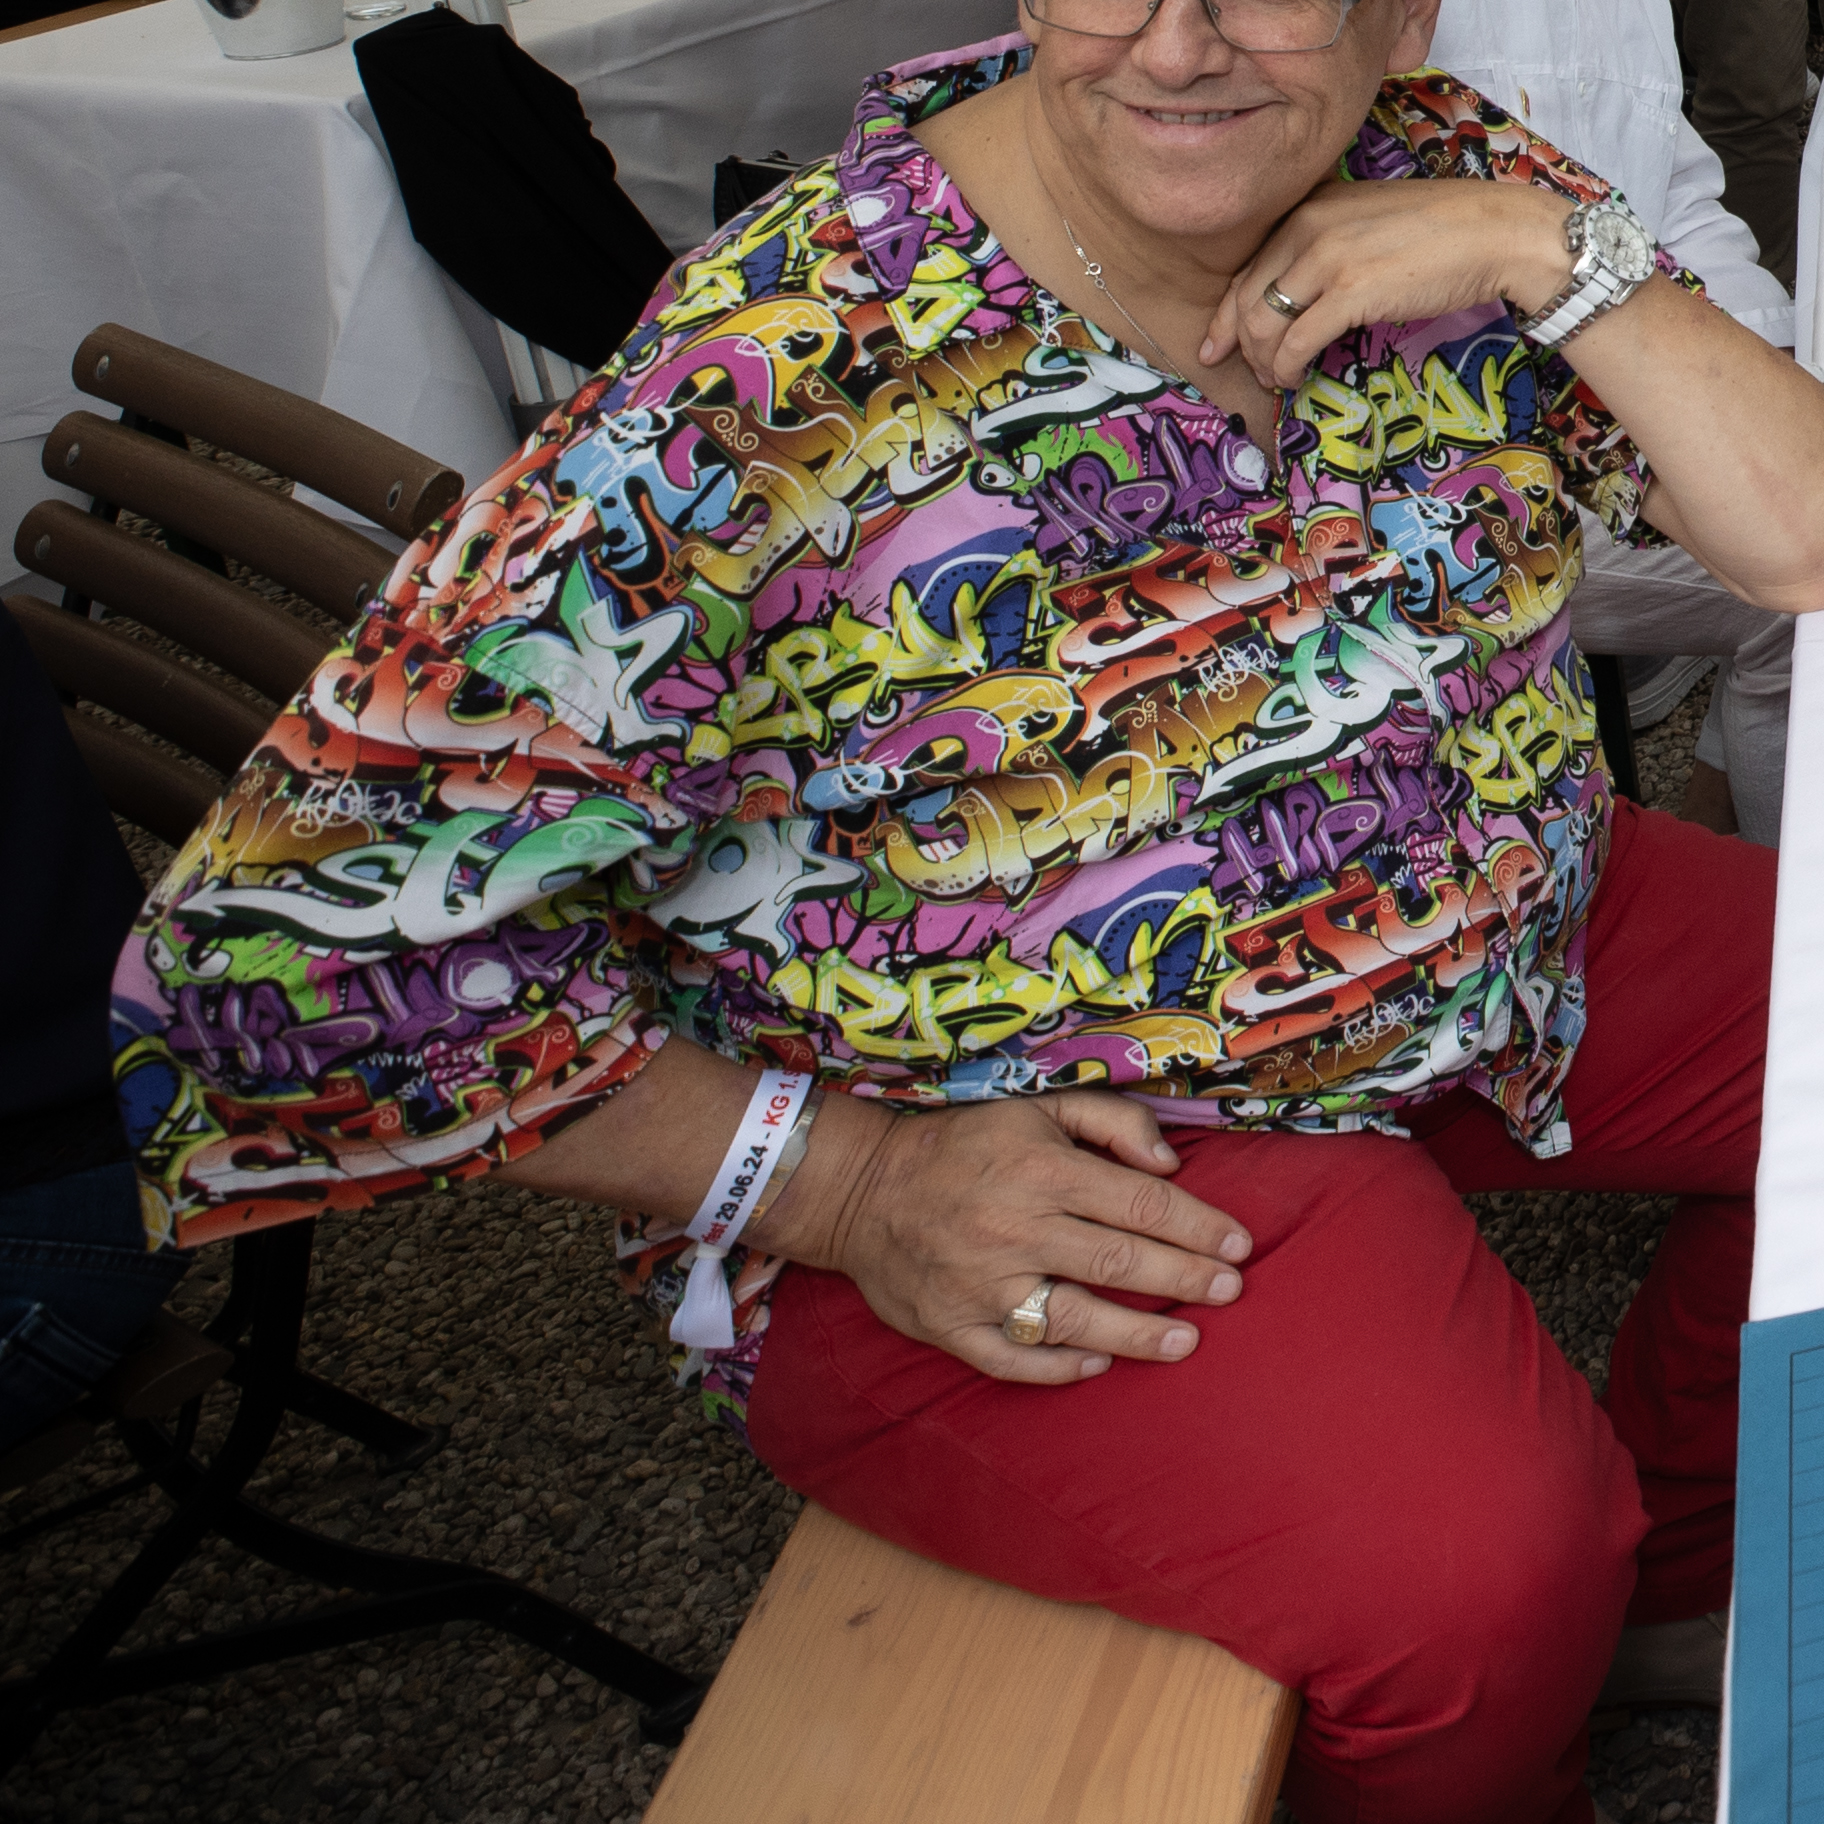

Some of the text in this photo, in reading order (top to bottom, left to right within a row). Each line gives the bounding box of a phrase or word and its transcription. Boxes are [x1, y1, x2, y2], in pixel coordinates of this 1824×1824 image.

[715, 1144, 769, 1222] 29.06.24
[762, 1095, 791, 1125] KG
[779, 1079, 799, 1090] 1.
